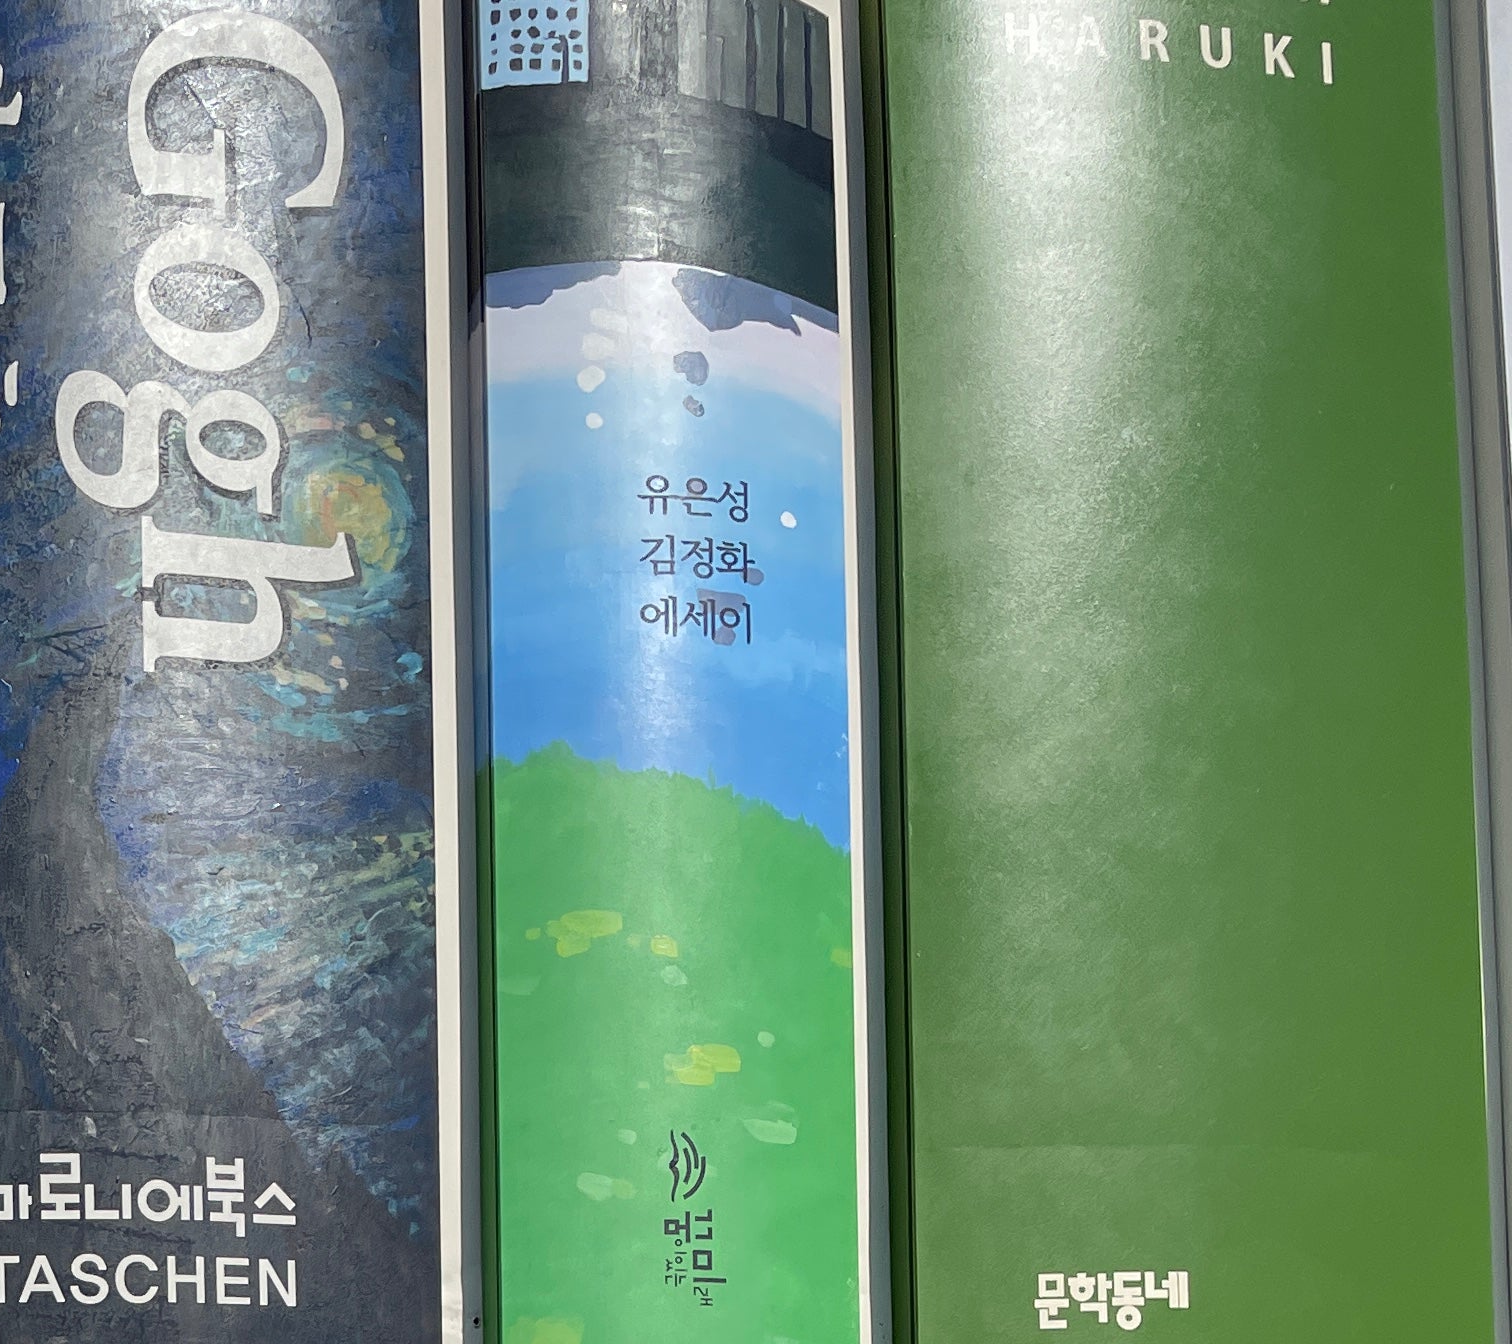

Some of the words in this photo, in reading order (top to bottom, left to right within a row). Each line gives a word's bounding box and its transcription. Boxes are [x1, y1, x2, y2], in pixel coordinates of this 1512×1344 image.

[1004, 12, 1334, 86] HARUKI
[55, 8, 357, 673] Gogh
[637, 473, 751, 524] 유은성
[639, 533, 755, 584] 김정화
[639, 595, 754, 645] 에세이
[1033, 1270, 1190, 1331] 문학동네
